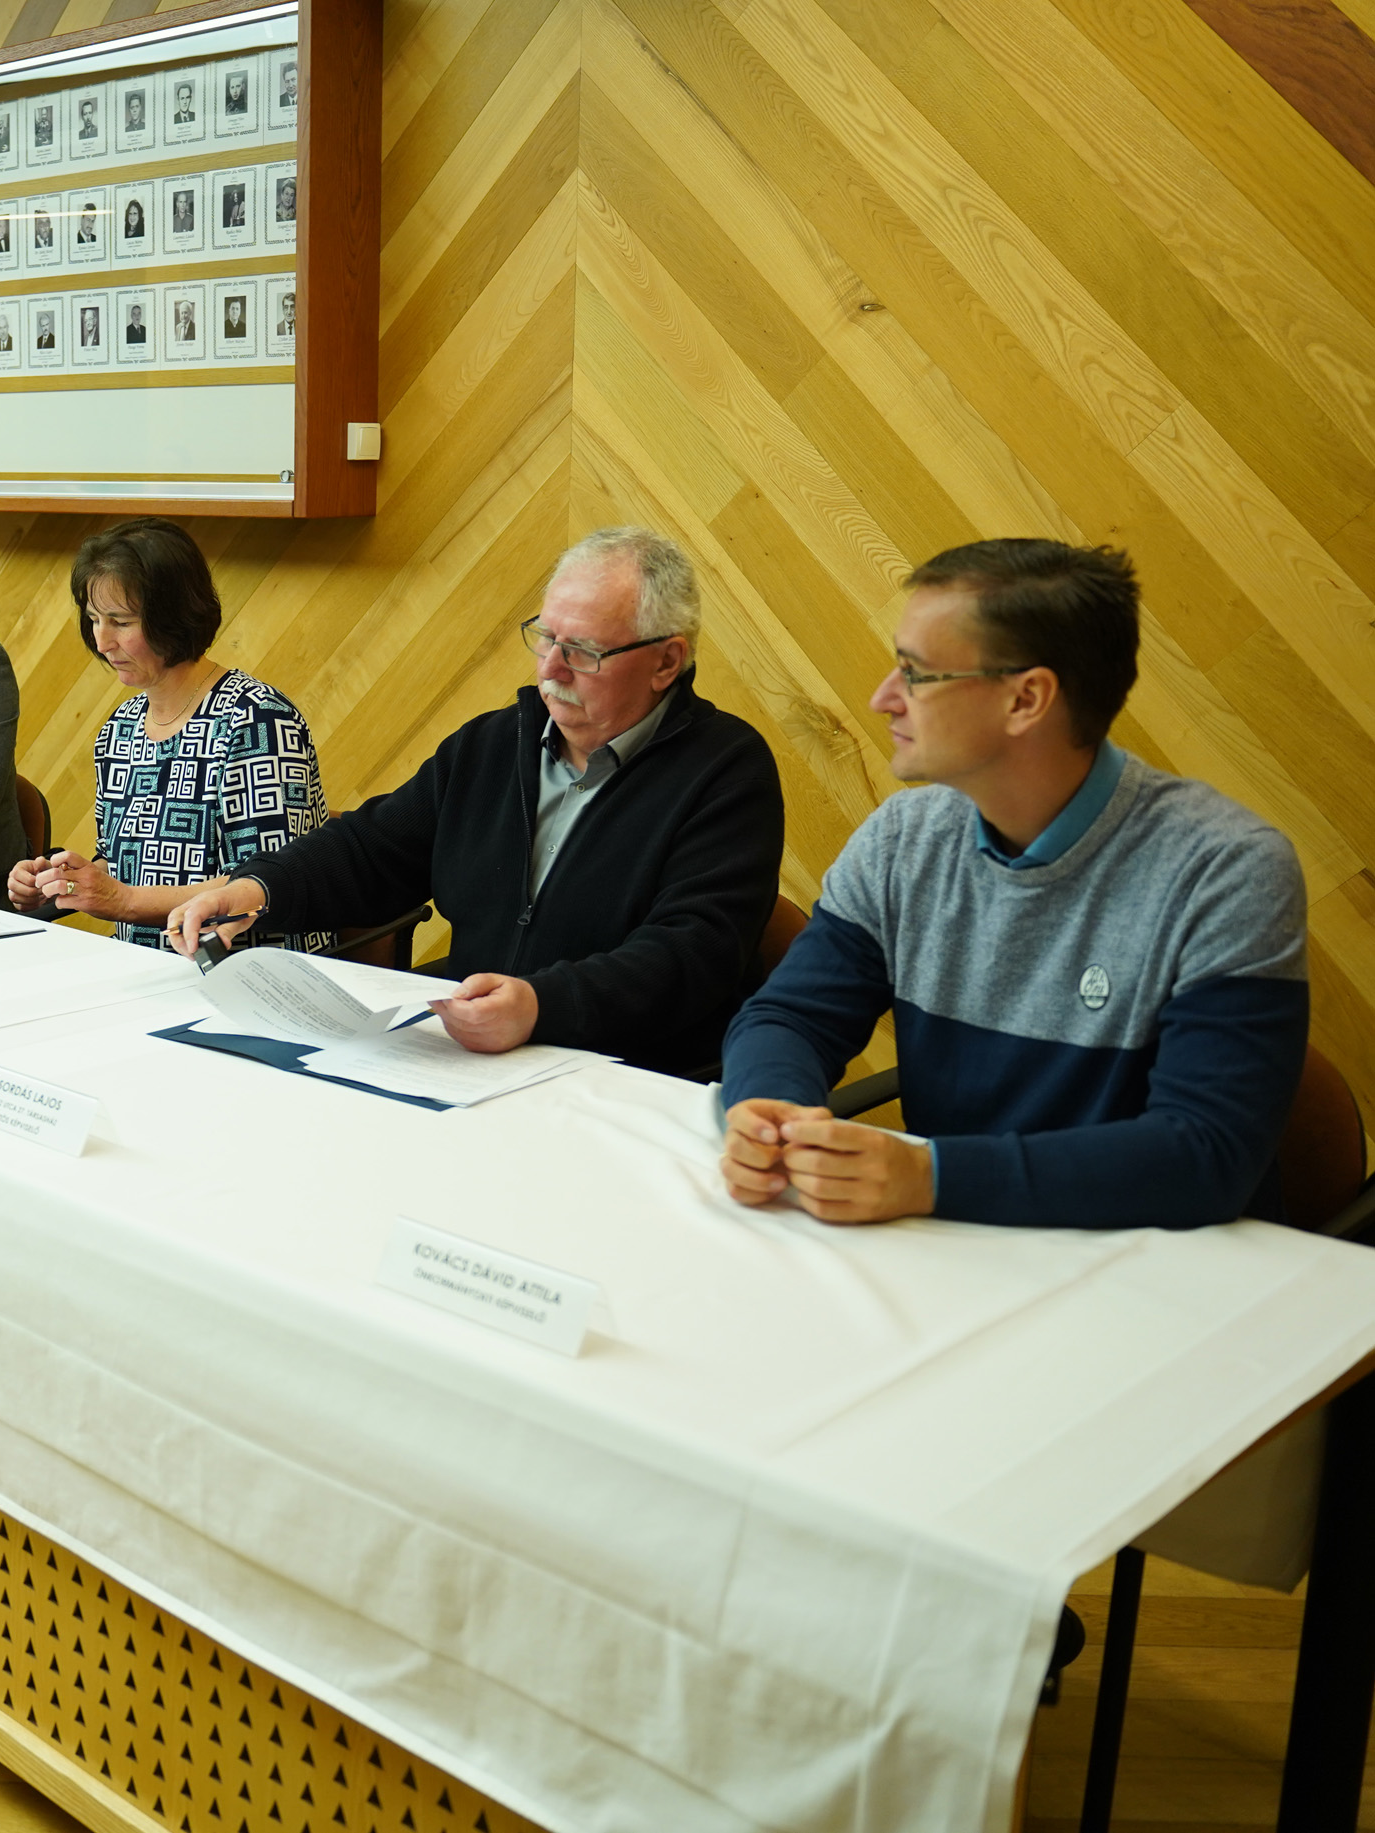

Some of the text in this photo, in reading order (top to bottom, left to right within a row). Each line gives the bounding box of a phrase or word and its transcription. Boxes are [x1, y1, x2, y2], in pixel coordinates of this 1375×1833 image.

[33, 1092, 63, 1111] LAJOS
[413, 1242, 563, 1306] KOVÁCS DÁVID ATTILA
